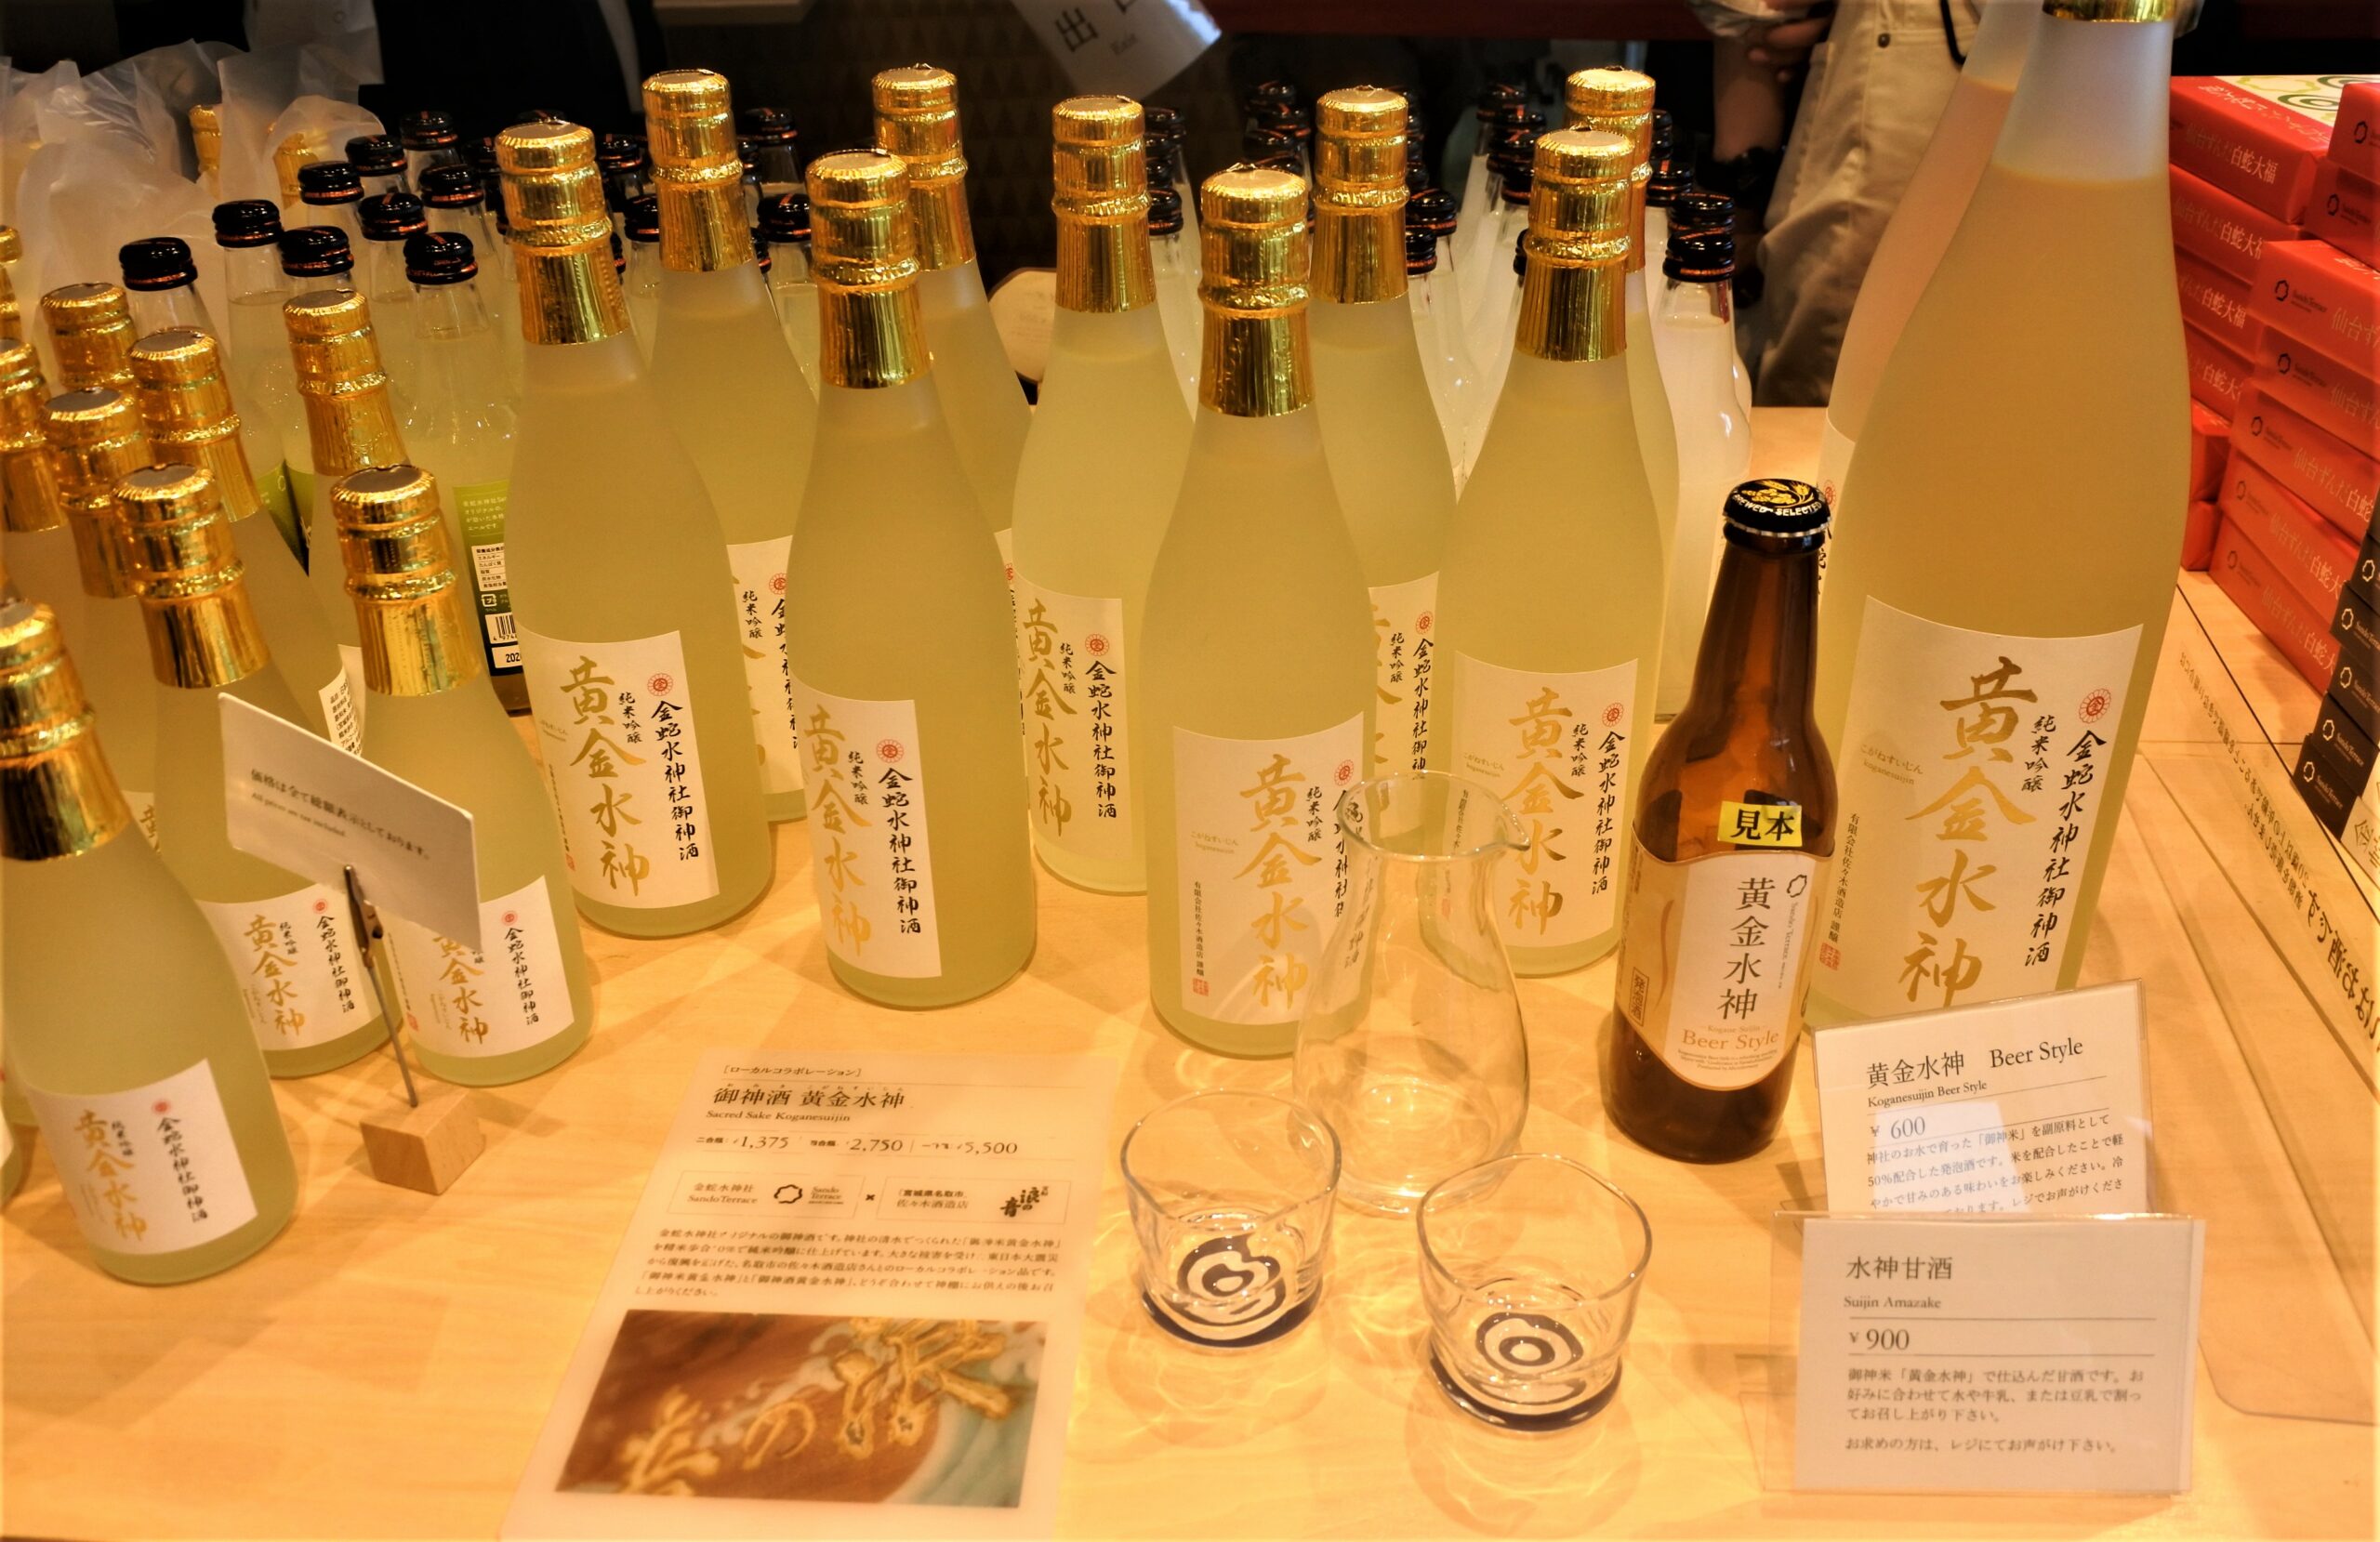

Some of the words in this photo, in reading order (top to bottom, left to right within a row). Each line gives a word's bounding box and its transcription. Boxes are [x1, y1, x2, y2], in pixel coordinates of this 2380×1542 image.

[743, 590, 763, 639] 純米吟醸
[1389, 632, 1405, 683] 純米吟醸
[618, 692, 643, 744] 純米吟醸
[1024, 598, 1078, 837] 黄金水神
[1085, 660, 1117, 819] 金蛇水神社御神酒
[561, 655, 650, 896] 黄金水神
[651, 700, 699, 861] 金蛇水神社御神酒
[847, 751, 868, 806] 純米吟醸
[1859, 744, 1924, 775] こがねすいじん
[2021, 714, 2057, 793] 純米吟醸
[803, 704, 873, 956] 黄金水神
[1305, 786, 1324, 842] 純米吟醸
[1501, 686, 1585, 937] 黄金水神
[1591, 731, 1626, 896] 金蛇水神社御神酒
[1730, 809, 1795, 841] 見本
[1897, 654, 2038, 1008] 黄金水神
[878, 767, 921, 934] 金蛇水神社御神酒
[1832, 812, 1860, 920] 有限会社佐々木酒造店
[2024, 729, 2108, 968] 金蛇水神社御神酒
[1234, 753, 1323, 1011] 黄金水神
[1717, 876, 1777, 1021] 黄金水神
[1682, 1029, 1729, 1050] Beer
[1736, 1030, 1779, 1052] Style
[1867, 1050, 1964, 1089] 黄金水神
[1990, 1047, 2033, 1068] Beer
[2040, 1037, 2083, 1064] Style
[706, 1110, 743, 1120] Sacred
[745, 1111, 773, 1120] Sake
[713, 1087, 793, 1106] 御神酒
[801, 1090, 906, 1110] 黄金水神
[1867, 1087, 1935, 1109] Koganesuijin
[1937, 1084, 1961, 1097] Beer
[1964, 1080, 1988, 1094] Style
[847, 1139, 904, 1152] 2,750
[1890, 1115, 1926, 1140] 600
[1845, 1256, 1953, 1280] 水神甘酒
[1844, 1296, 1879, 1310] Suijin
[1883, 1296, 1941, 1310] Amazake
[1866, 1328, 1911, 1351] 900
